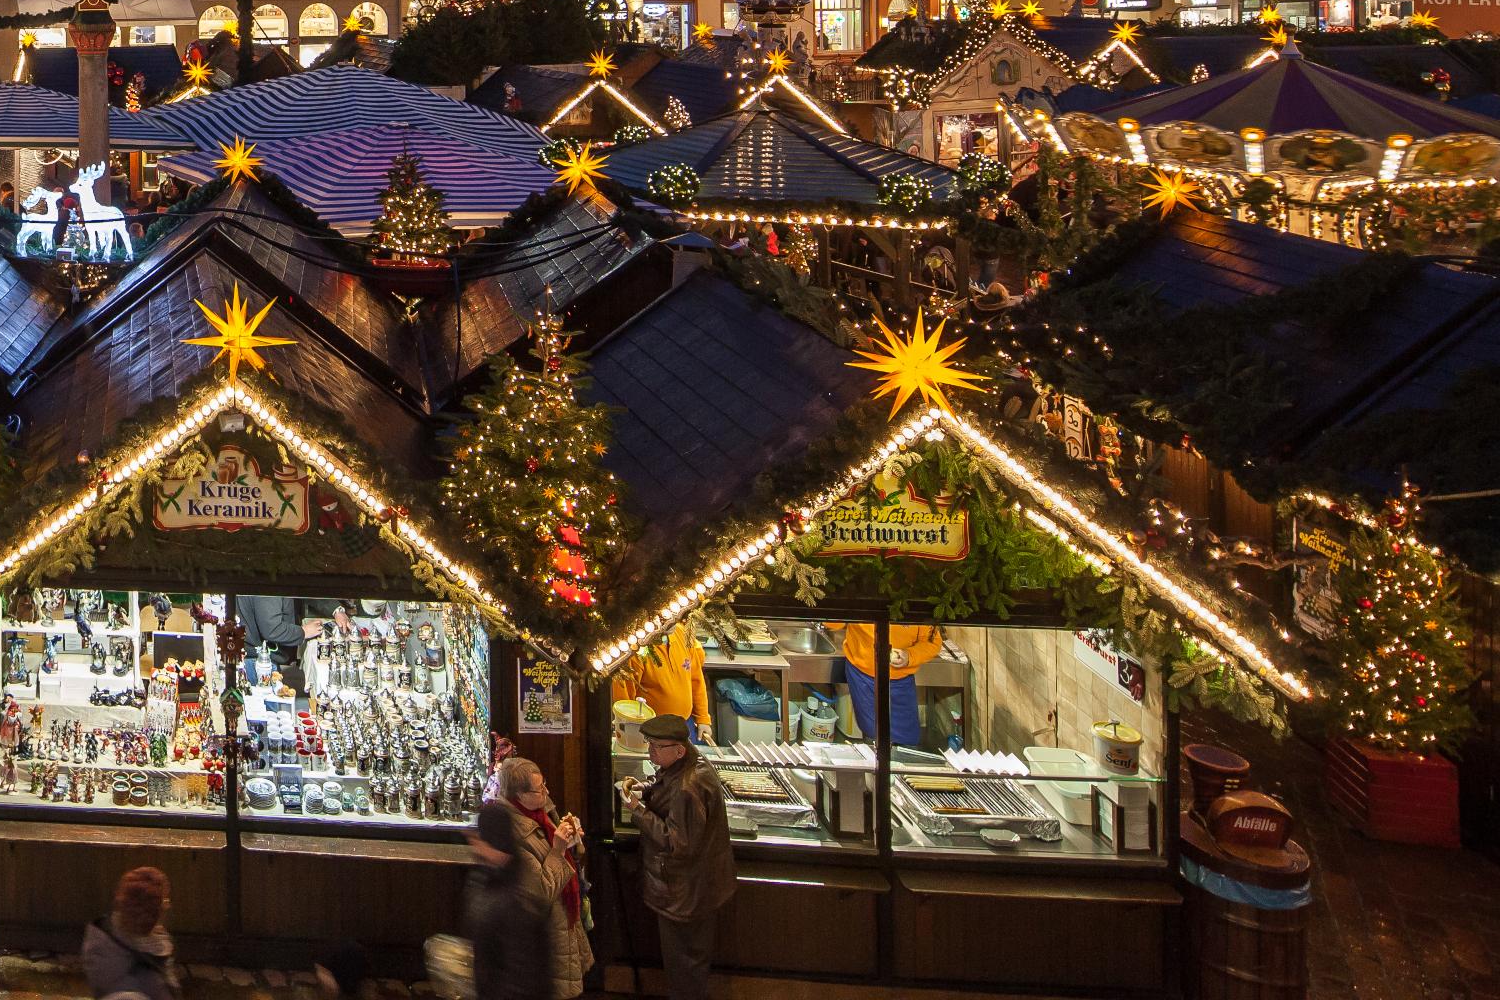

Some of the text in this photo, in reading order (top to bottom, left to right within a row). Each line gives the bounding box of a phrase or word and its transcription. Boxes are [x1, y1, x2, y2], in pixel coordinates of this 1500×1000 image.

[200, 481, 261, 502] Krüge
[188, 499, 274, 518] Keramik
[820, 522, 950, 545] Bratwurst
[809, 728, 830, 740] Senf
[1105, 752, 1132, 769] Senf
[1233, 816, 1277, 832] Abfälle
